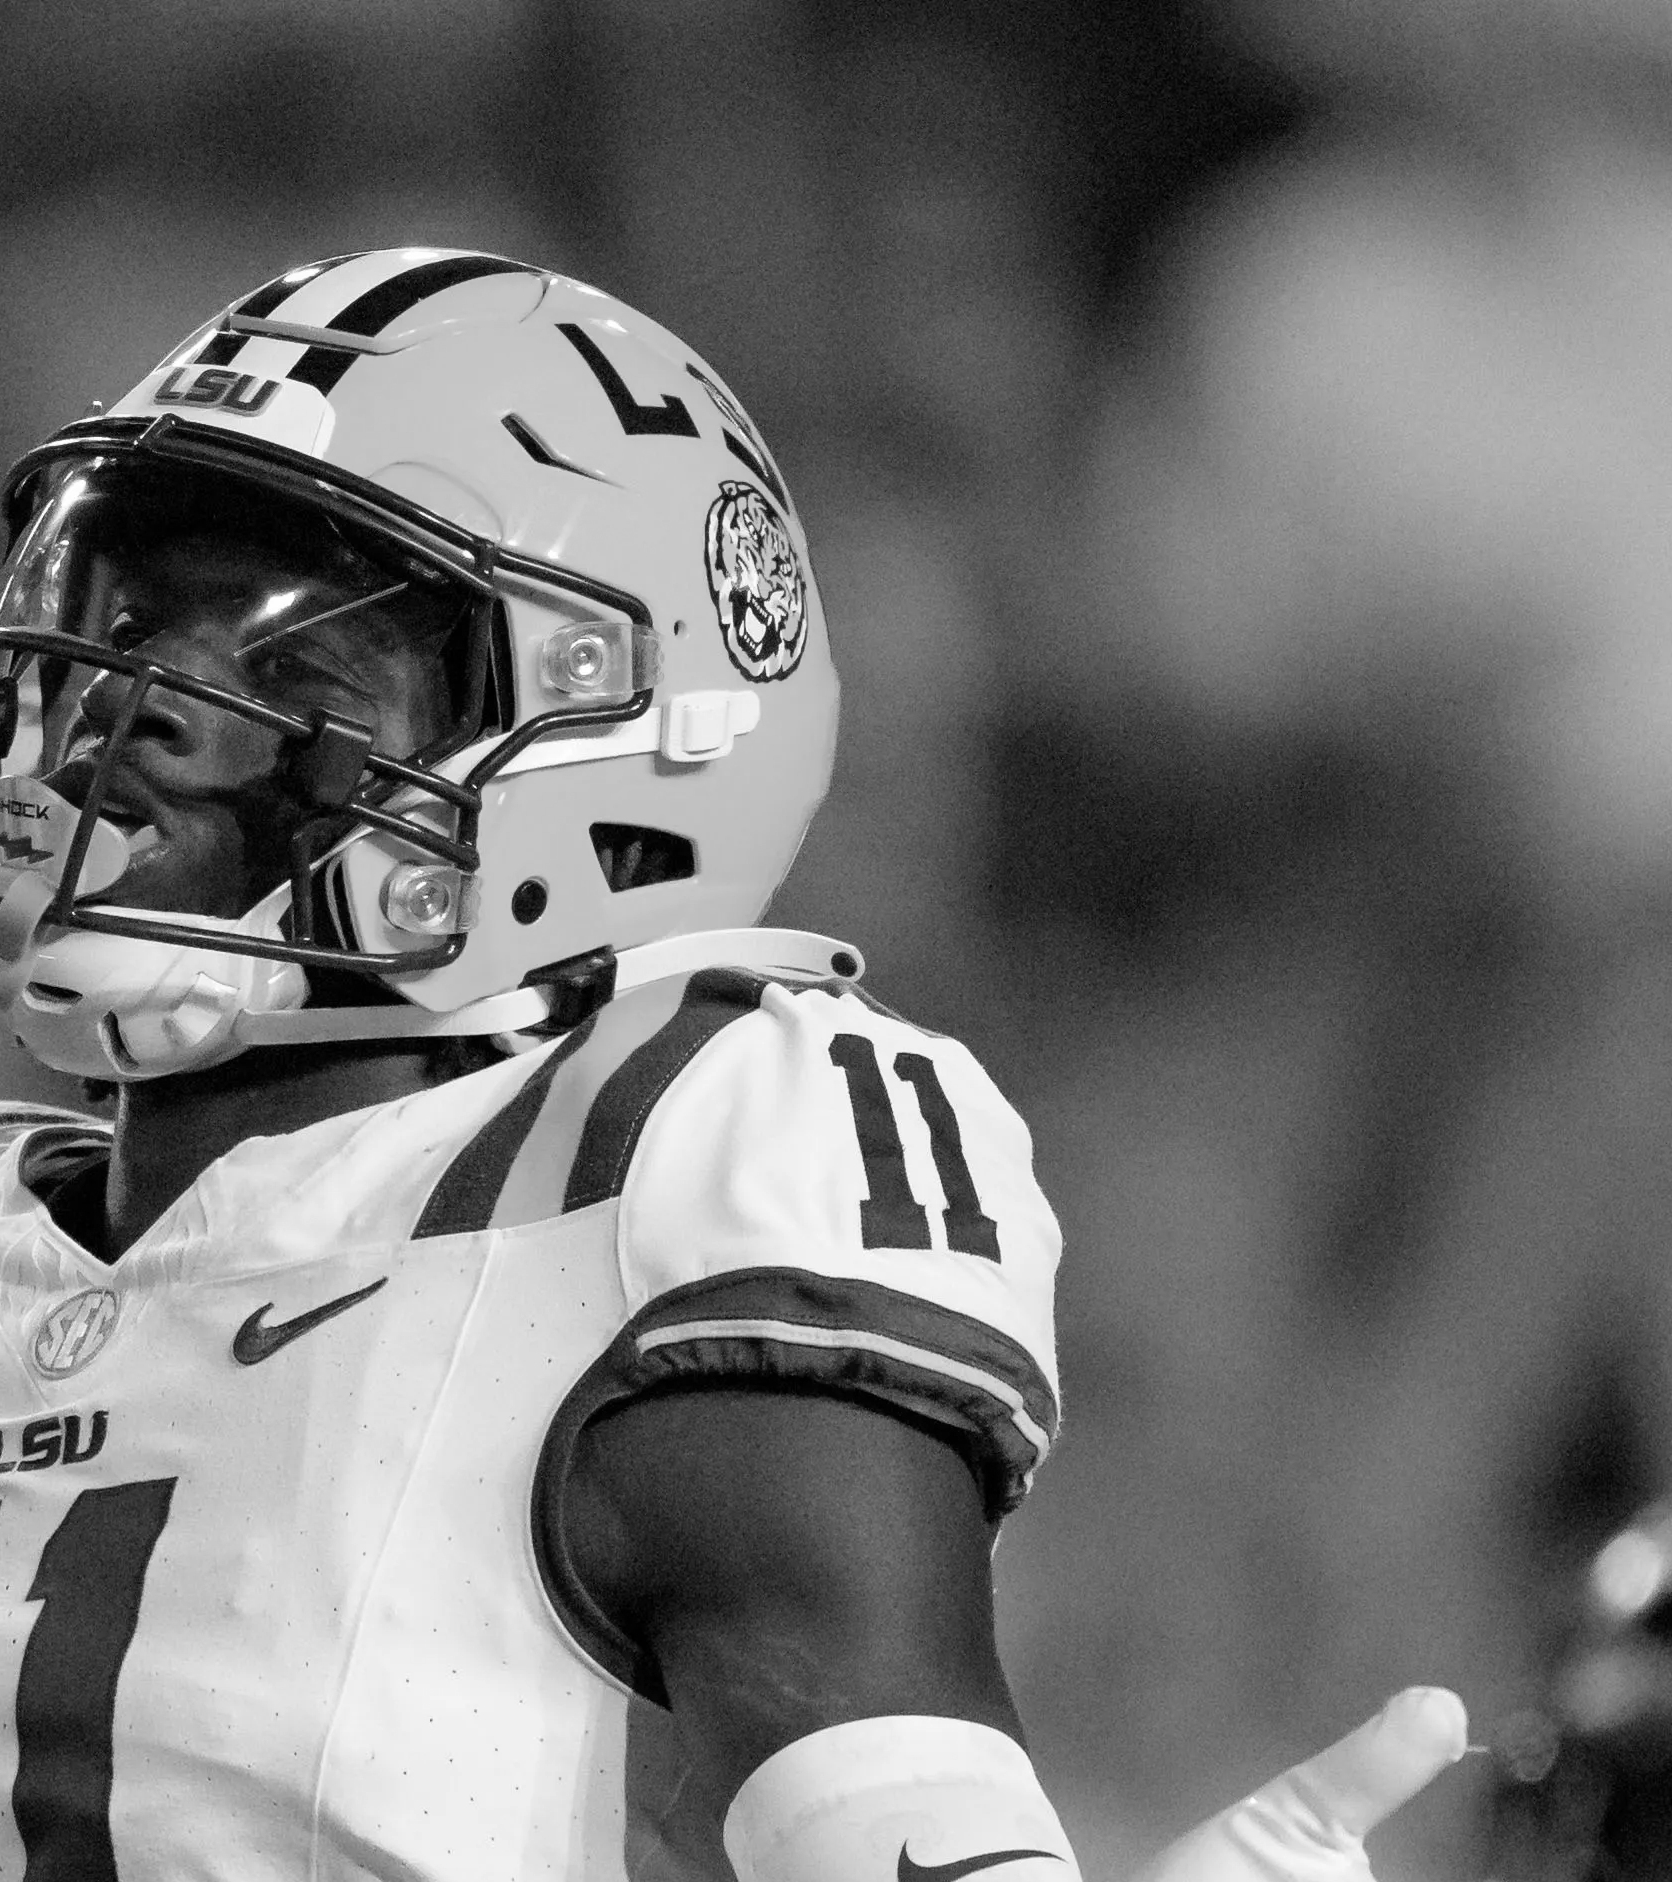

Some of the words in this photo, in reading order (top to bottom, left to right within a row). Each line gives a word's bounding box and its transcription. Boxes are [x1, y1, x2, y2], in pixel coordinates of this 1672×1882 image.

[153, 366, 282, 418] LSU
[828, 1033, 1002, 1265] 11
[35, 1291, 118, 1371] SEC
